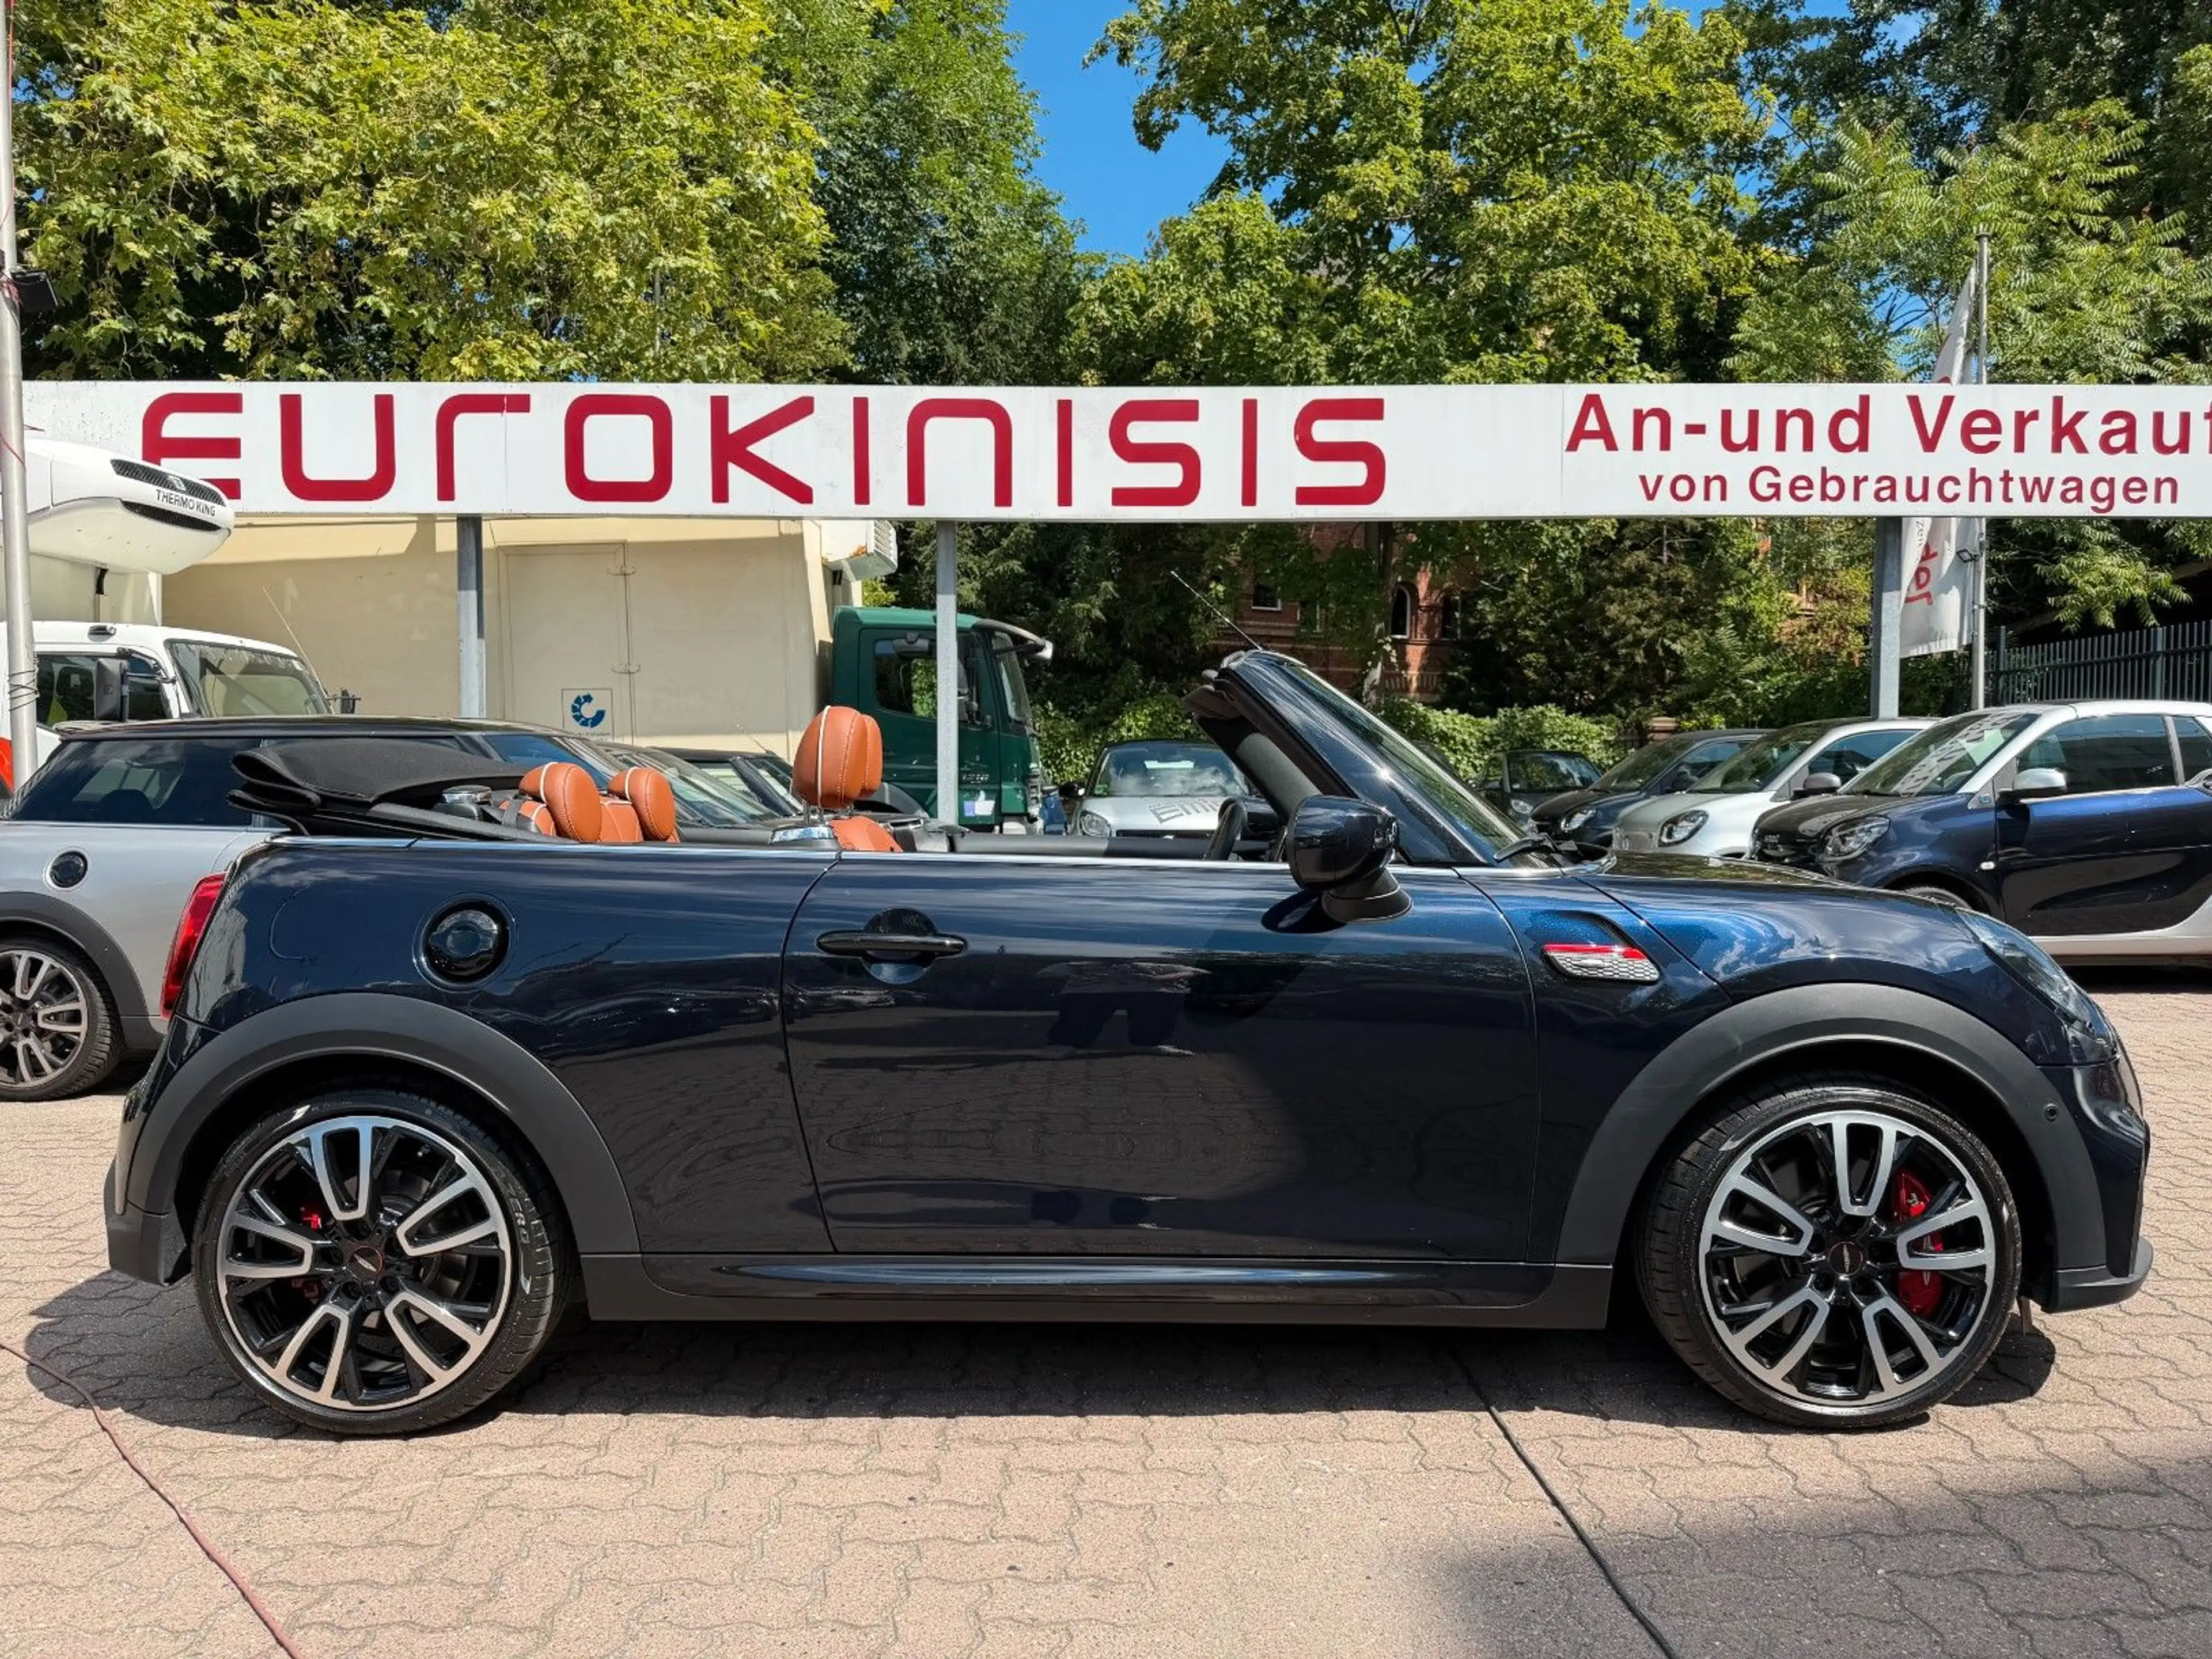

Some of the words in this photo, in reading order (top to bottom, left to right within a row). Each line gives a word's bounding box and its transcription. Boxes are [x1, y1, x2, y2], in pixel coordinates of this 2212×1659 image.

[1565, 393, 1870, 453] An-und
[156, 489, 195, 510] THERMO
[196, 501, 215, 517] KING
[1639, 474, 1728, 502] von
[1748, 465, 2179, 514] Gebrauchtwagen
